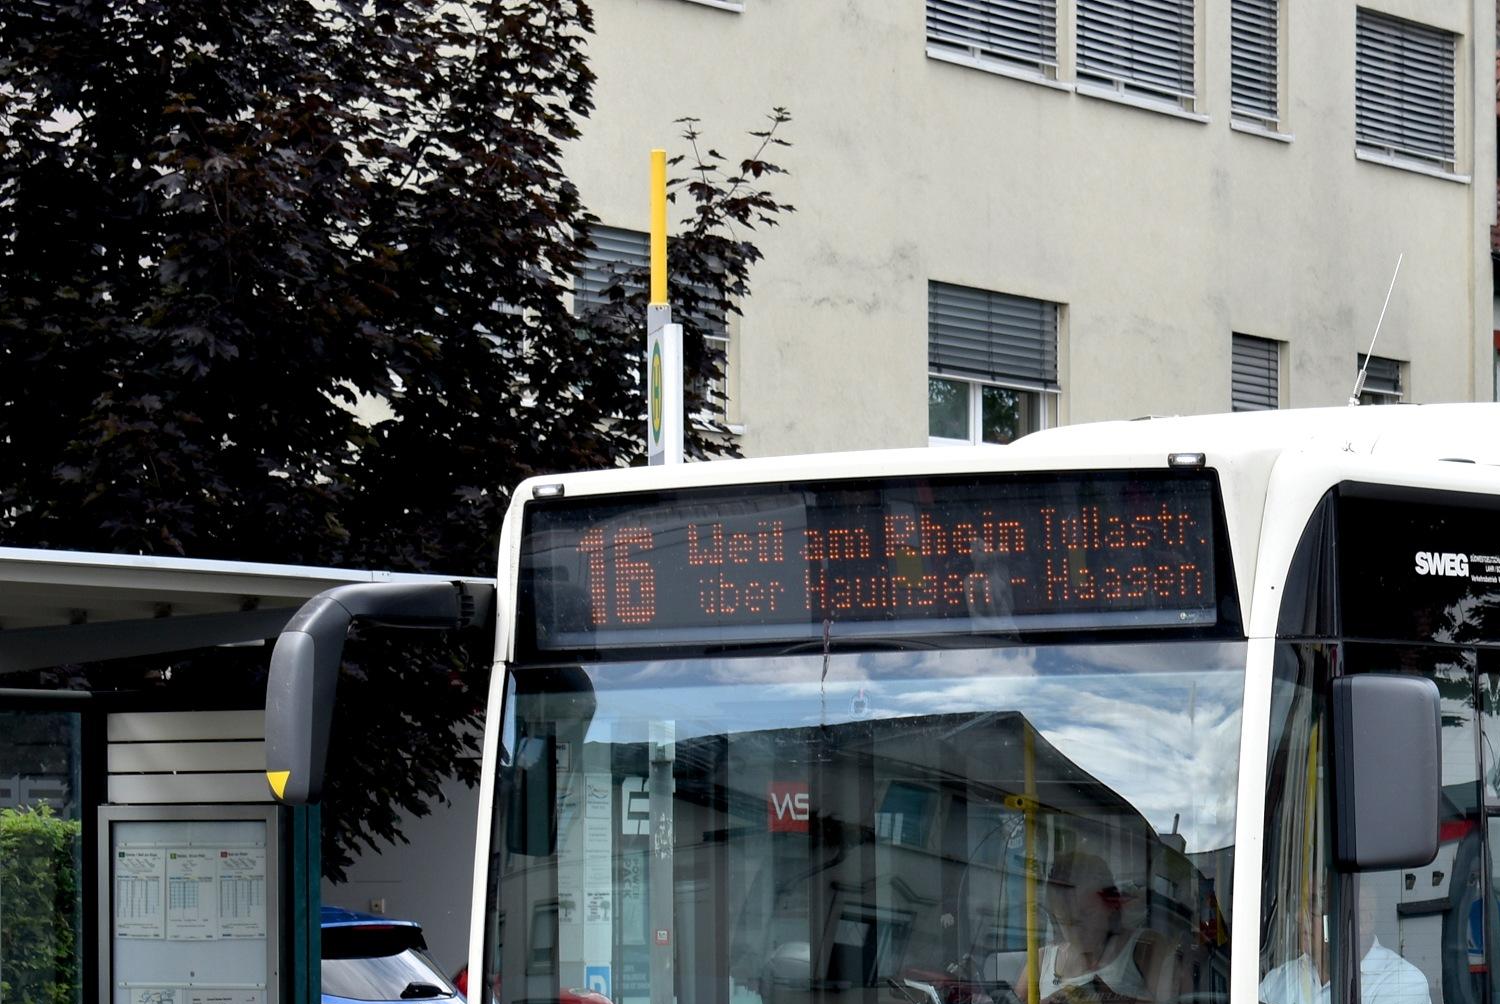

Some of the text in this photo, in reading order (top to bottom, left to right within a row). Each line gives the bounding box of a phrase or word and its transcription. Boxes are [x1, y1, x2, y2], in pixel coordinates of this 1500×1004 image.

[687, 503, 1206, 565] Weil am Rhein Tullastr.
[1414, 550, 1470, 577] SWEG
[575, 527, 656, 624] 16
[698, 571, 785, 614] über
[804, 566, 990, 610] Hauingen
[1047, 557, 1202, 601] Haagen
